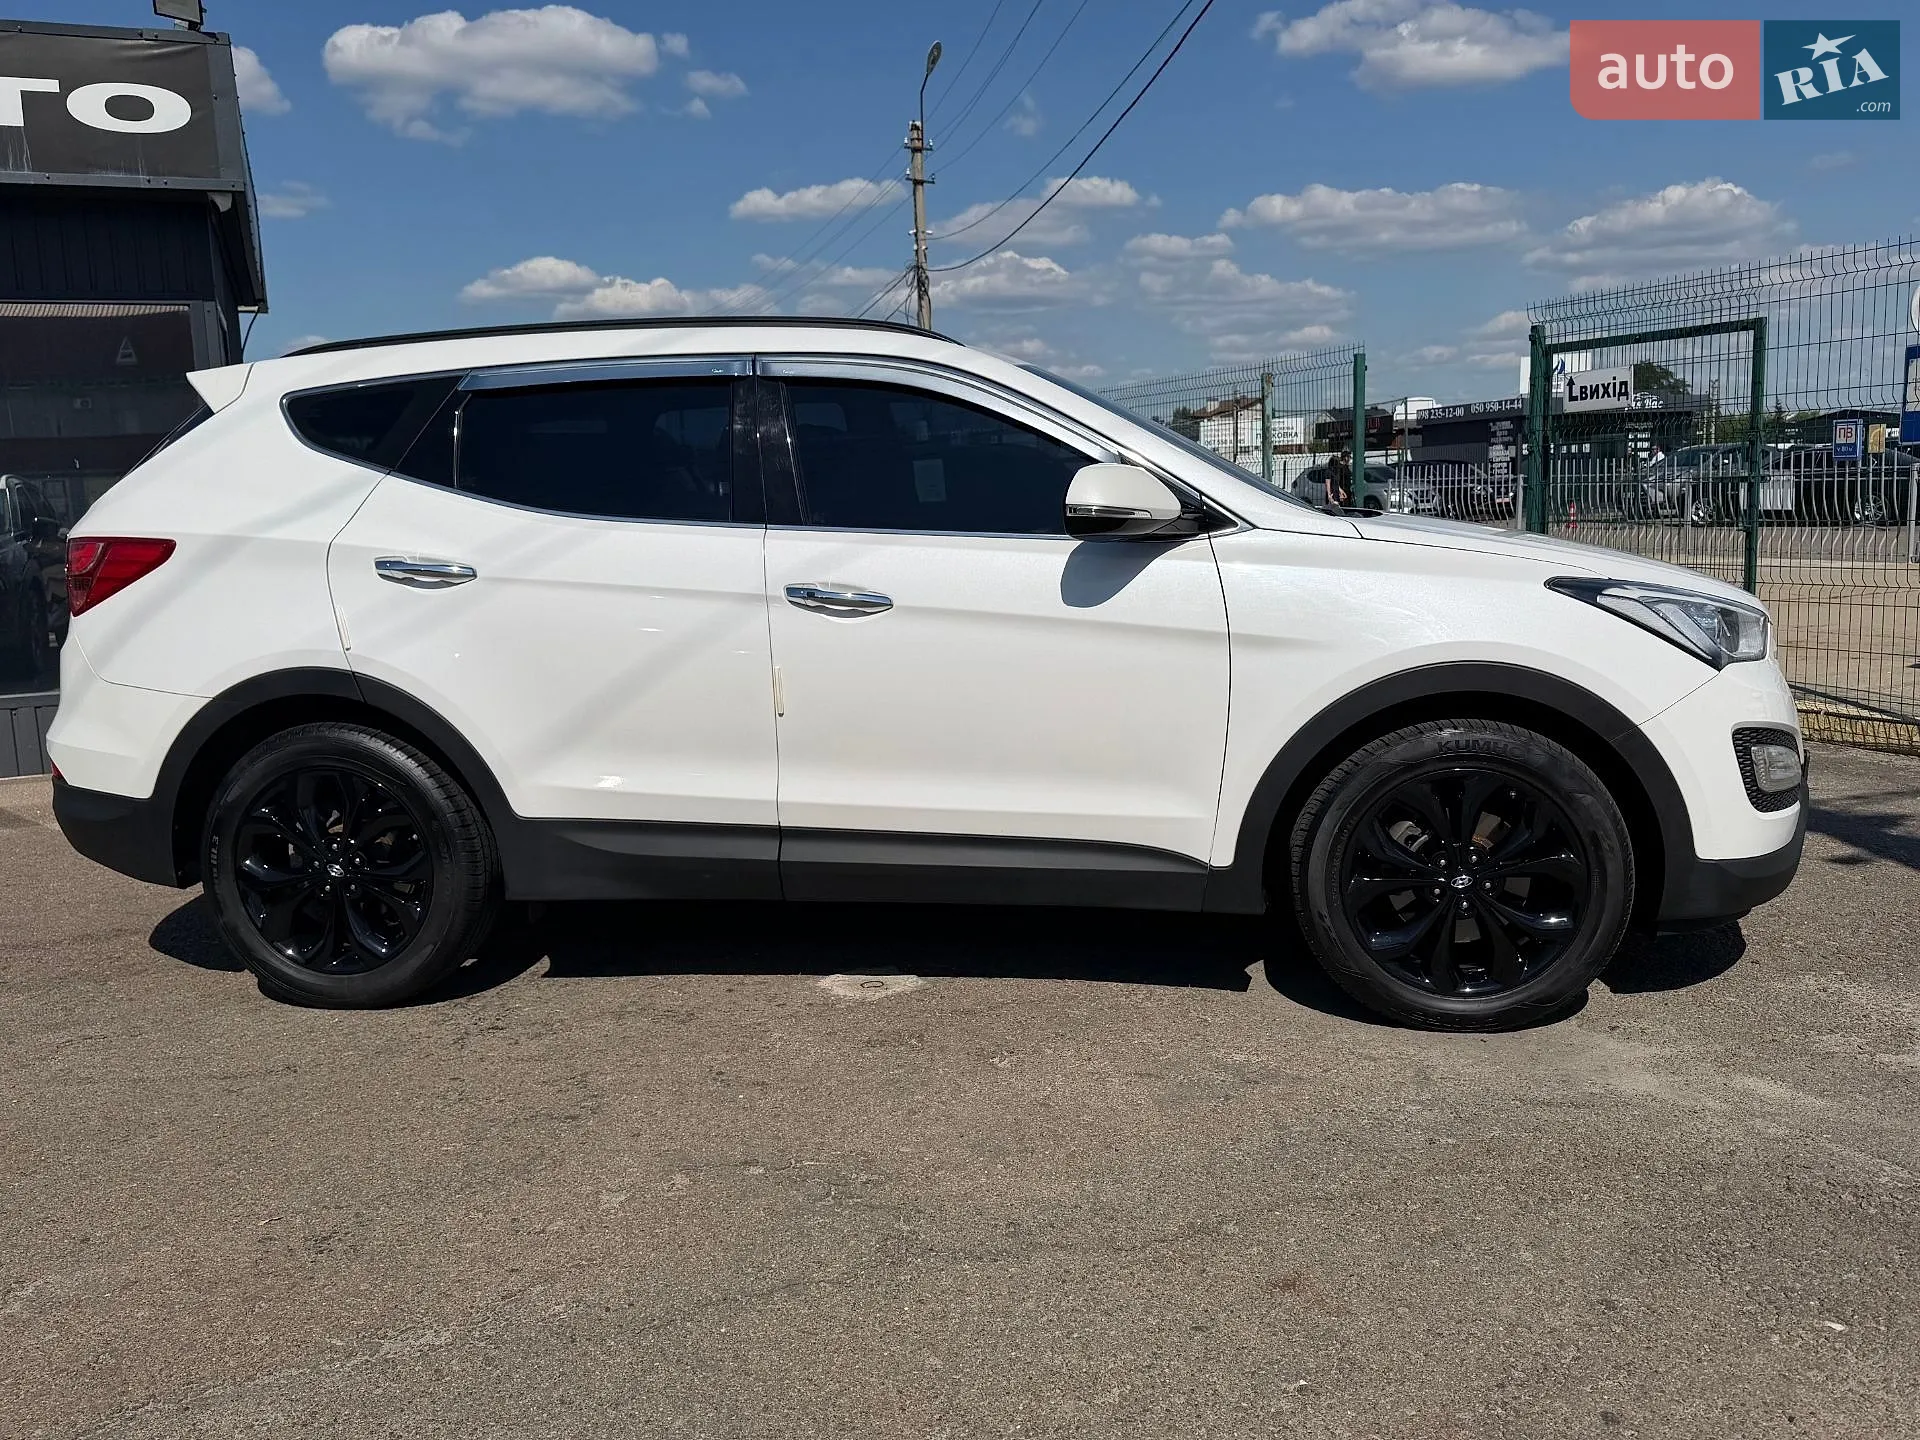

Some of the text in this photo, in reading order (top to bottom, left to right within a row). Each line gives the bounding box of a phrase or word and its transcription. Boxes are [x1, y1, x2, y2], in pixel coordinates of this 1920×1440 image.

[1430, 406, 1465, 419] 235-12-00
[1470, 403, 1484, 414] 050
[1485, 399, 1522, 413] 950-14-44
